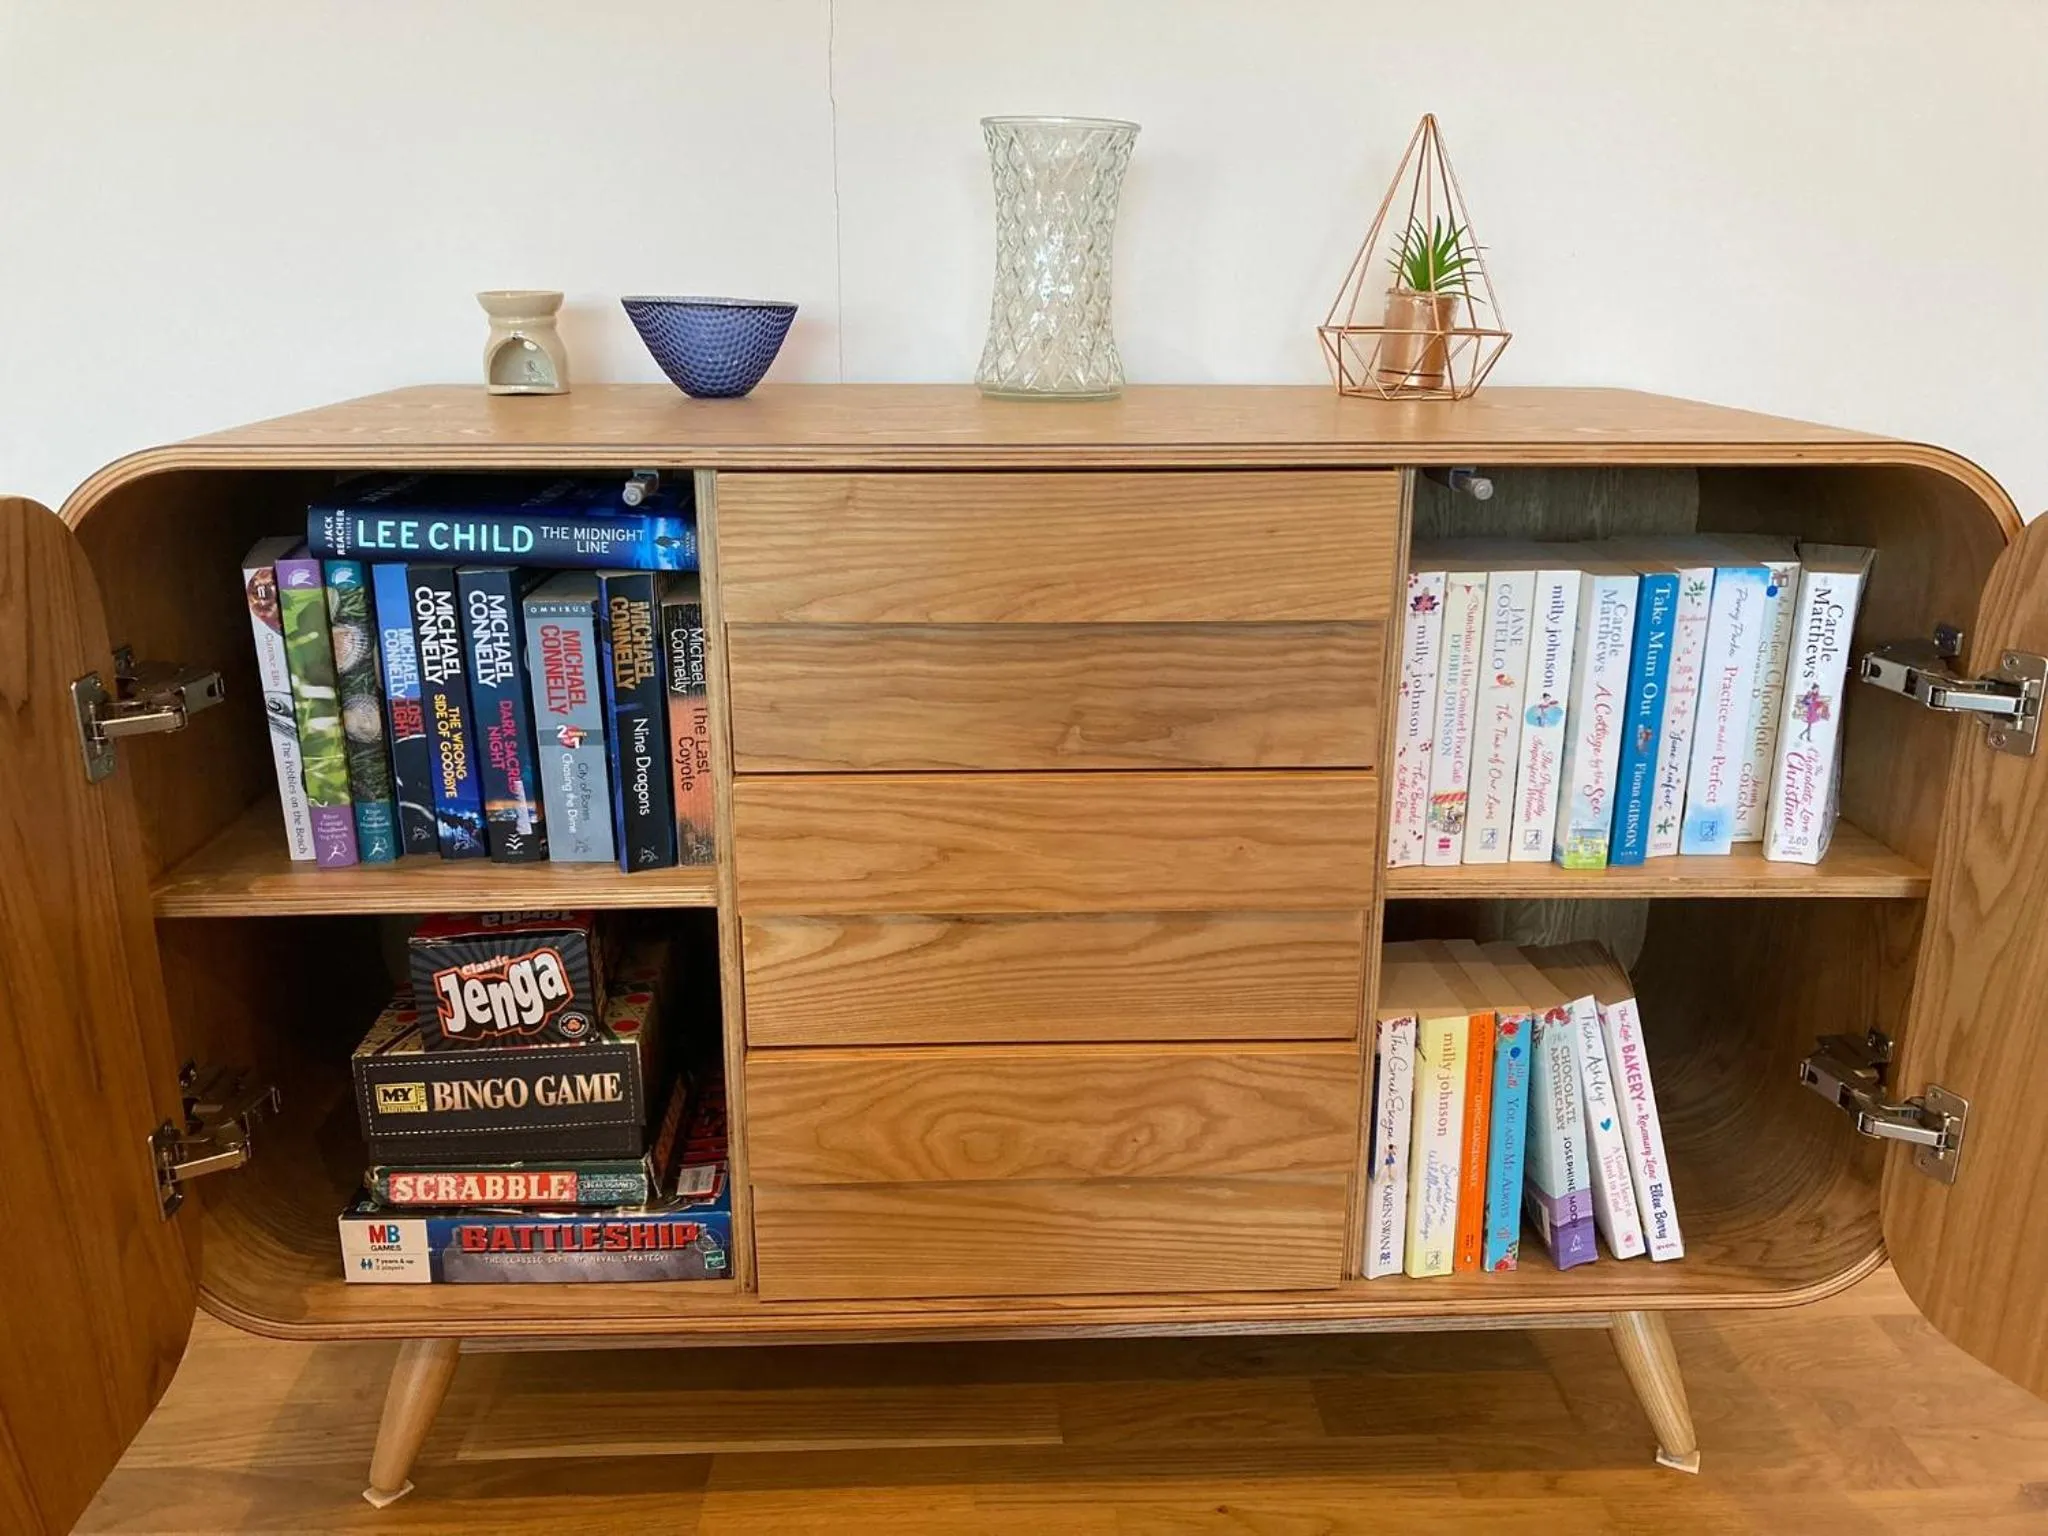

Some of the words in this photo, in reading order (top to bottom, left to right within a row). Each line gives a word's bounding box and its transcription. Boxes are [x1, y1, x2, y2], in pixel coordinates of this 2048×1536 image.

[324, 516, 334, 541] JACK
[336, 510, 346, 555] REACHER
[357, 519, 420, 549] LEE
[428, 522, 534, 552] CHILD
[541, 526, 570, 540] THE
[573, 527, 646, 542] MIDNIGHT
[576, 541, 610, 554] LINE
[530, 605, 587, 614] OMNIBUS
[1547, 585, 1564, 624] milly
[1651, 582, 1672, 625] Take
[414, 586, 444, 686] CONNELLY
[433, 591, 461, 680] MICHAEL
[468, 590, 498, 689] CONNELLY
[487, 594, 515, 684] MICHAEL
[611, 596, 637, 690] CONNELLY
[629, 600, 655, 685] MICHAEL
[1411, 625, 1429, 664] milly
[1492, 583, 1512, 670] COSTELLO
[1510, 608, 1525, 647] JANE
[1594, 588, 1618, 673] Matthews
[1607, 603, 1628, 657] Carole
[1803, 587, 1832, 679] Matthews
[1820, 604, 1844, 662] Carole
[384, 628, 406, 699] CONNELLY
[397, 627, 419, 689] MICHAEL
[540, 623, 569, 716] CONNELLY
[561, 629, 588, 711] MICHAEL
[670, 628, 692, 694] Connelly
[689, 627, 706, 687] Michael
[1447, 633, 1462, 685] DEBBIE
[1543, 626, 1562, 688] johnson
[1644, 631, 1665, 677] Mum
[434, 693, 448, 719] SIDE
[1409, 672, 1426, 737] johnson
[1594, 681, 1613, 701] A
[1639, 682, 1659, 717] Out
[1718, 665, 1738, 723] Practice
[392, 699, 411, 737] LIGHT
[406, 699, 423, 733] LOST
[437, 720, 451, 738] OF
[448, 706, 462, 729] THE
[500, 700, 517, 738] DARK
[556, 724, 568, 738] 2
[692, 707, 708, 736] The
[1441, 690, 1457, 757] JOHNSON
[1496, 703, 1513, 722] The
[1587, 702, 1614, 754] Cottage
[282, 741, 292, 759] The
[487, 725, 506, 770] NIGHT
[633, 718, 648, 753] Nine
[440, 741, 458, 799] GOODBYE
[451, 732, 468, 780] WRONG
[561, 753, 574, 792] Chasing
[577, 762, 589, 780] City
[676, 736, 695, 792] Coyote
[695, 741, 711, 774] Last
[580, 783, 592, 794] of
[633, 756, 651, 816] Dragons
[1631, 763, 1647, 798] Fiona
[1707, 755, 1726, 804] Perfect
[292, 795, 299, 808] on
[293, 811, 301, 825] the
[1583, 784, 1605, 819] Sea
[295, 828, 307, 855] Beach
[567, 810, 578, 834] Dime
[1624, 798, 1641, 848] GIBSON
[461, 954, 510, 976] Classic
[439, 952, 567, 1033] Jenga
[1390, 1031, 1409, 1058] The
[1439, 1032, 1457, 1071] milly
[431, 1077, 529, 1112] BINGO
[534, 1072, 623, 1107] GAME
[1550, 1047, 1565, 1131] APOTHECARY
[1561, 1045, 1577, 1124] CHOCOLATE
[1436, 1074, 1454, 1137] johnson
[1506, 1097, 1519, 1124] YOU
[1622, 1043, 1646, 1101] BAKERY
[1637, 1113, 1652, 1156] Rosemary
[1649, 1183, 1664, 1208] Ellen
[1564, 1136, 1577, 1193] JOSEPHINE
[392, 1174, 570, 1202] SCRABBLE
[1382, 1184, 1394, 1219] KAREN
[1499, 1177, 1513, 1218] ALWAYS
[1567, 1195, 1579, 1228] MOON
[368, 1224, 401, 1244] MB
[370, 1244, 402, 1252] GAMES
[460, 1222, 702, 1252] BATTLESHIP
[1379, 1220, 1392, 1250] SWAN
[381, 1258, 399, 1267] years
